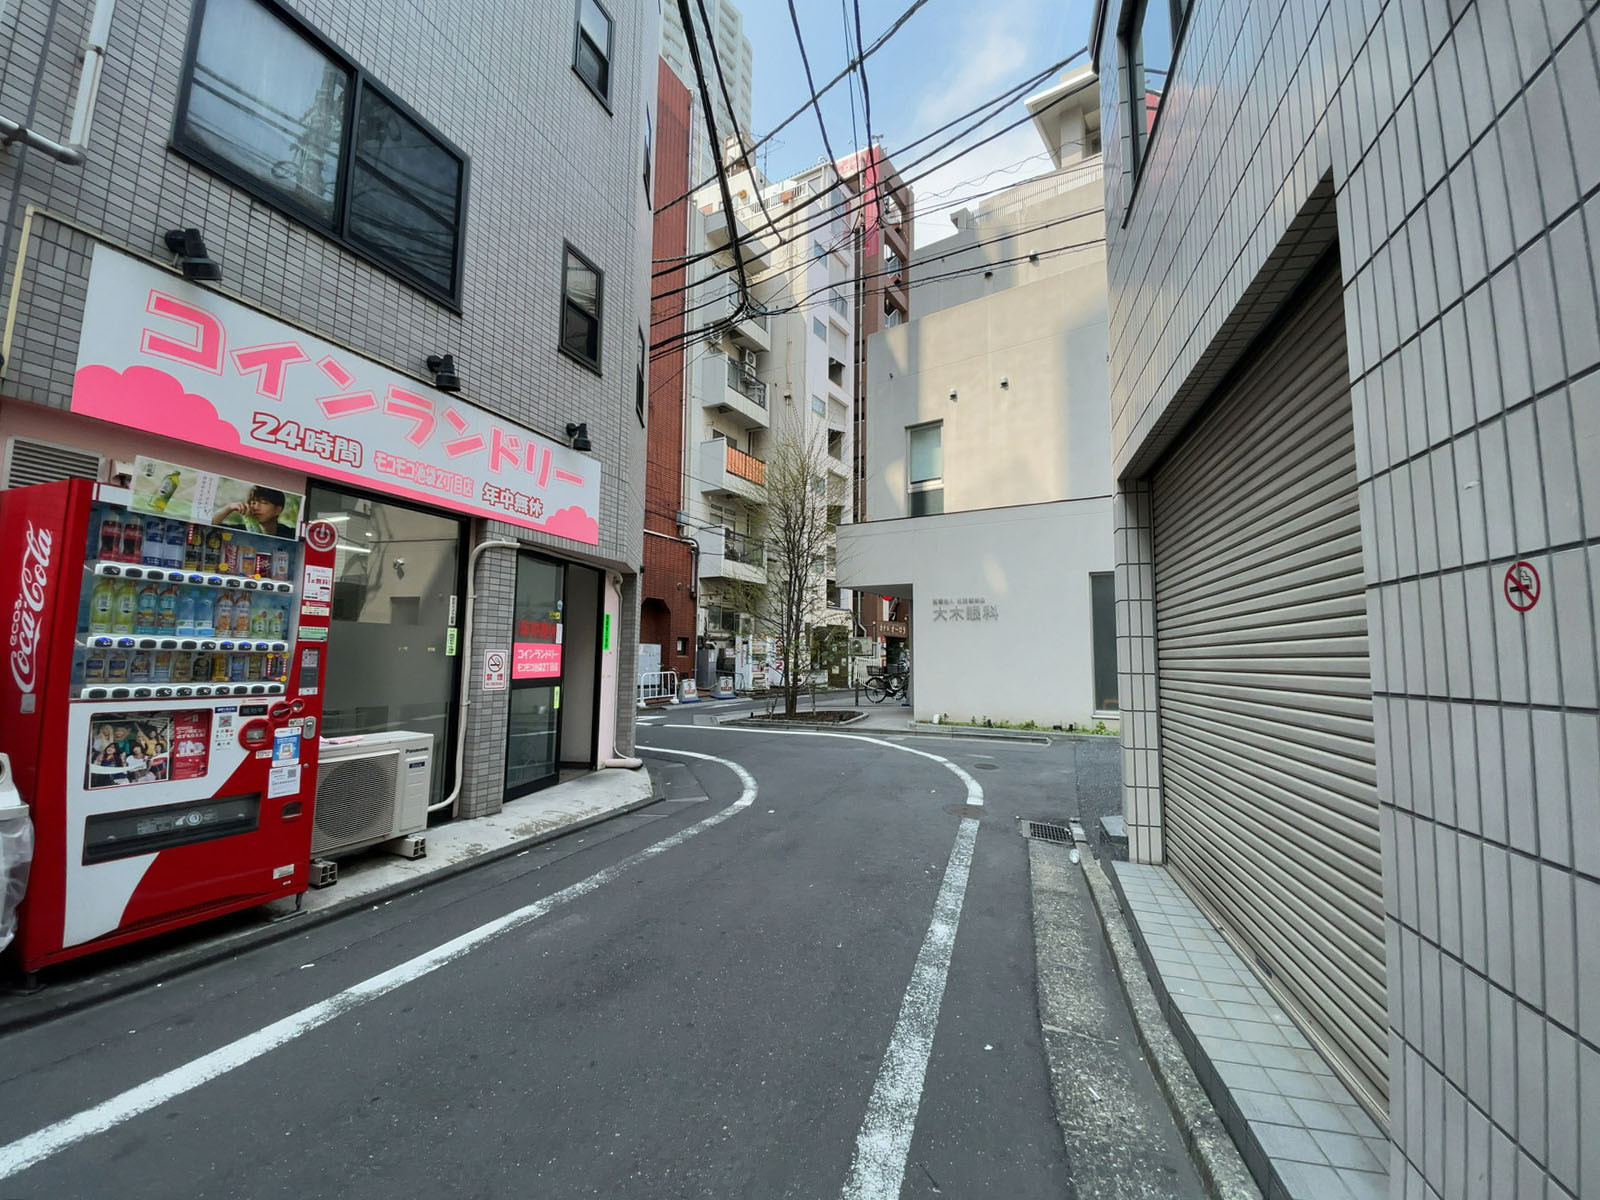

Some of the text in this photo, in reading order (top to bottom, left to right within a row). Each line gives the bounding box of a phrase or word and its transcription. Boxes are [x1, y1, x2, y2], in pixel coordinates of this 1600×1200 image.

[139, 288, 585, 490] コインランドリー
[250, 411, 543, 518] 24時間 モコモコ池袋2丁目店 年中無休
[11, 520, 52, 693] Coca-Cola
